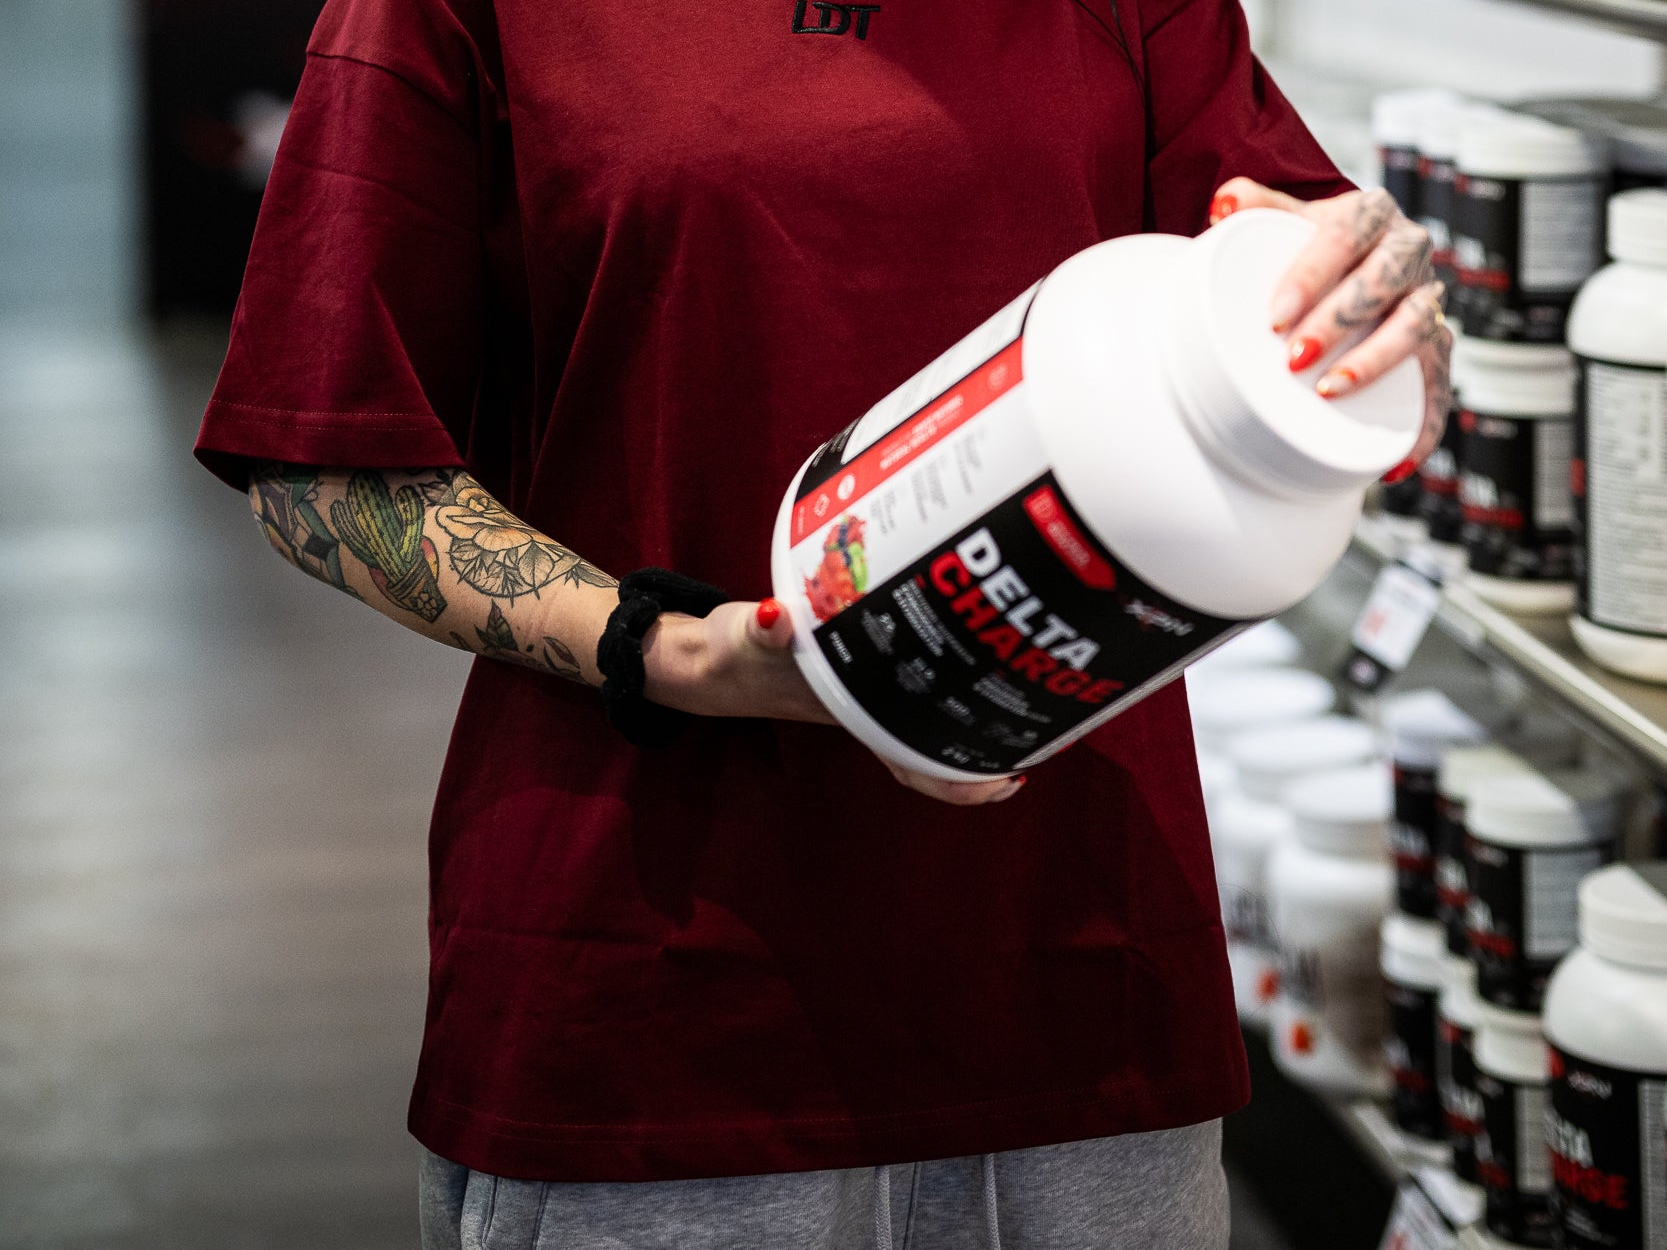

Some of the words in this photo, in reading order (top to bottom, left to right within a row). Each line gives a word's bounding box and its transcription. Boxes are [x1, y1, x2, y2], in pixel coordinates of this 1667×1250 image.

[791, 0, 881, 41] LDT
[928, 549, 1126, 704] CHARGE
[954, 526, 1101, 672] DELTA
